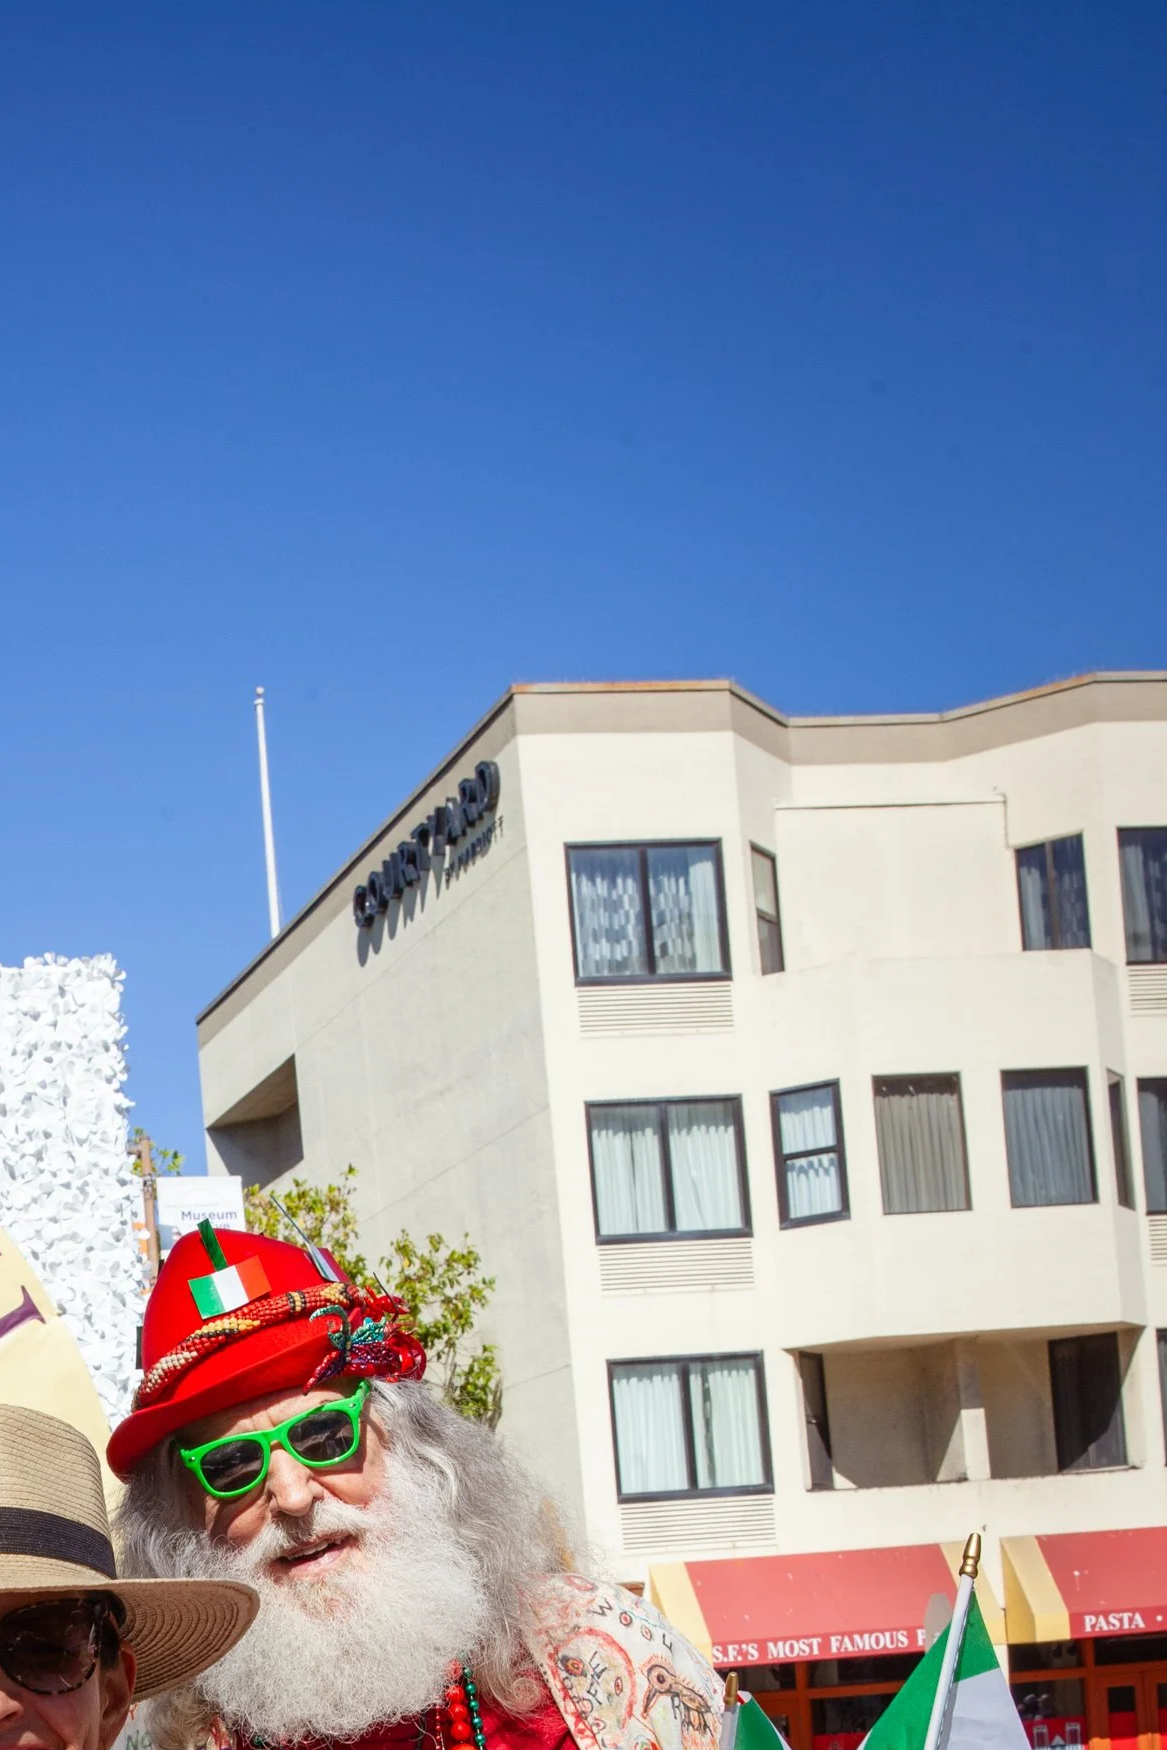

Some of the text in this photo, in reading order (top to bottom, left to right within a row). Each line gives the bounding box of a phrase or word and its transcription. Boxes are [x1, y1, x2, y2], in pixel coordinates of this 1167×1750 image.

[180, 1209, 238, 1221] Museum
[1083, 1611, 1146, 1632] PASTA
[712, 1643, 759, 1663] S.F.'S
[767, 1638, 822, 1659] MOST
[831, 1631, 908, 1653] FAMOUS
